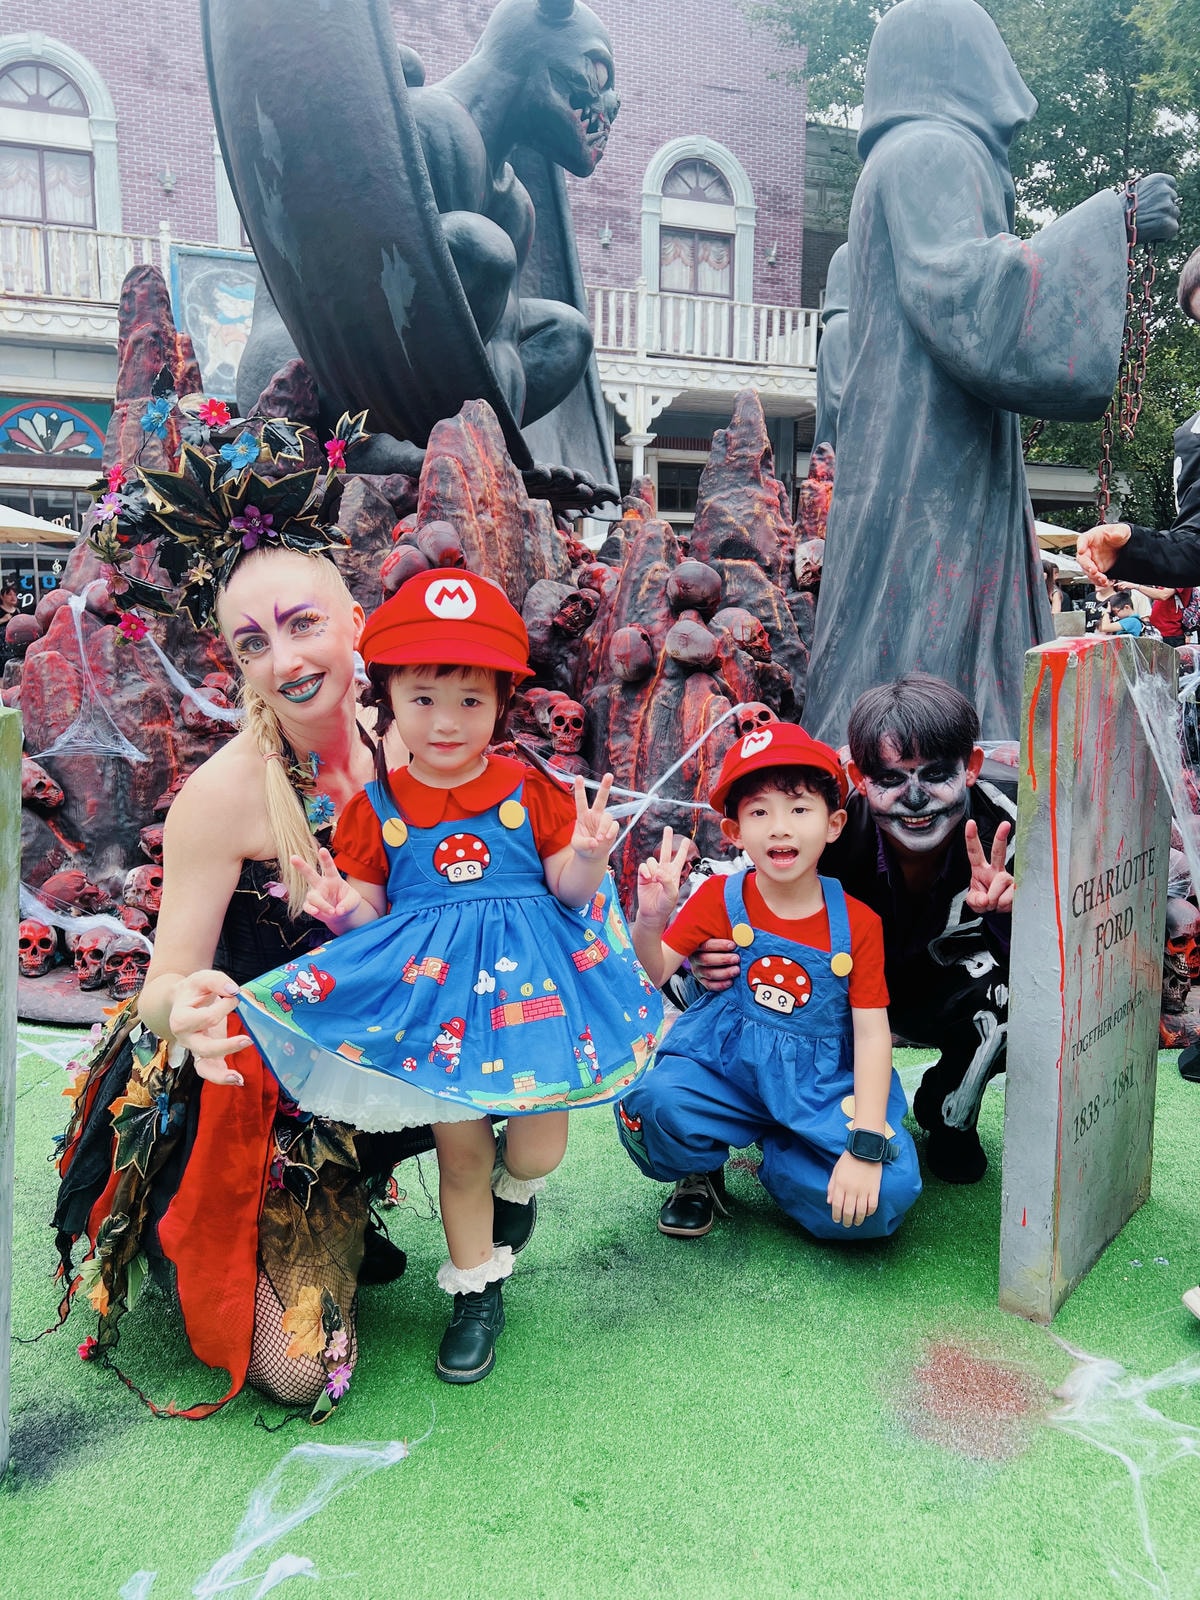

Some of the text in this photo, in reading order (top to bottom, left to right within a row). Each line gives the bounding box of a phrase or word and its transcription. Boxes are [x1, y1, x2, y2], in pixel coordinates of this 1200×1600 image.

[434, 585, 469, 606] M
[1072, 846, 1155, 918] CHARLOTTE
[1094, 906, 1134, 958] FORD
[1072, 1015, 1113, 1061] TOGETHER
